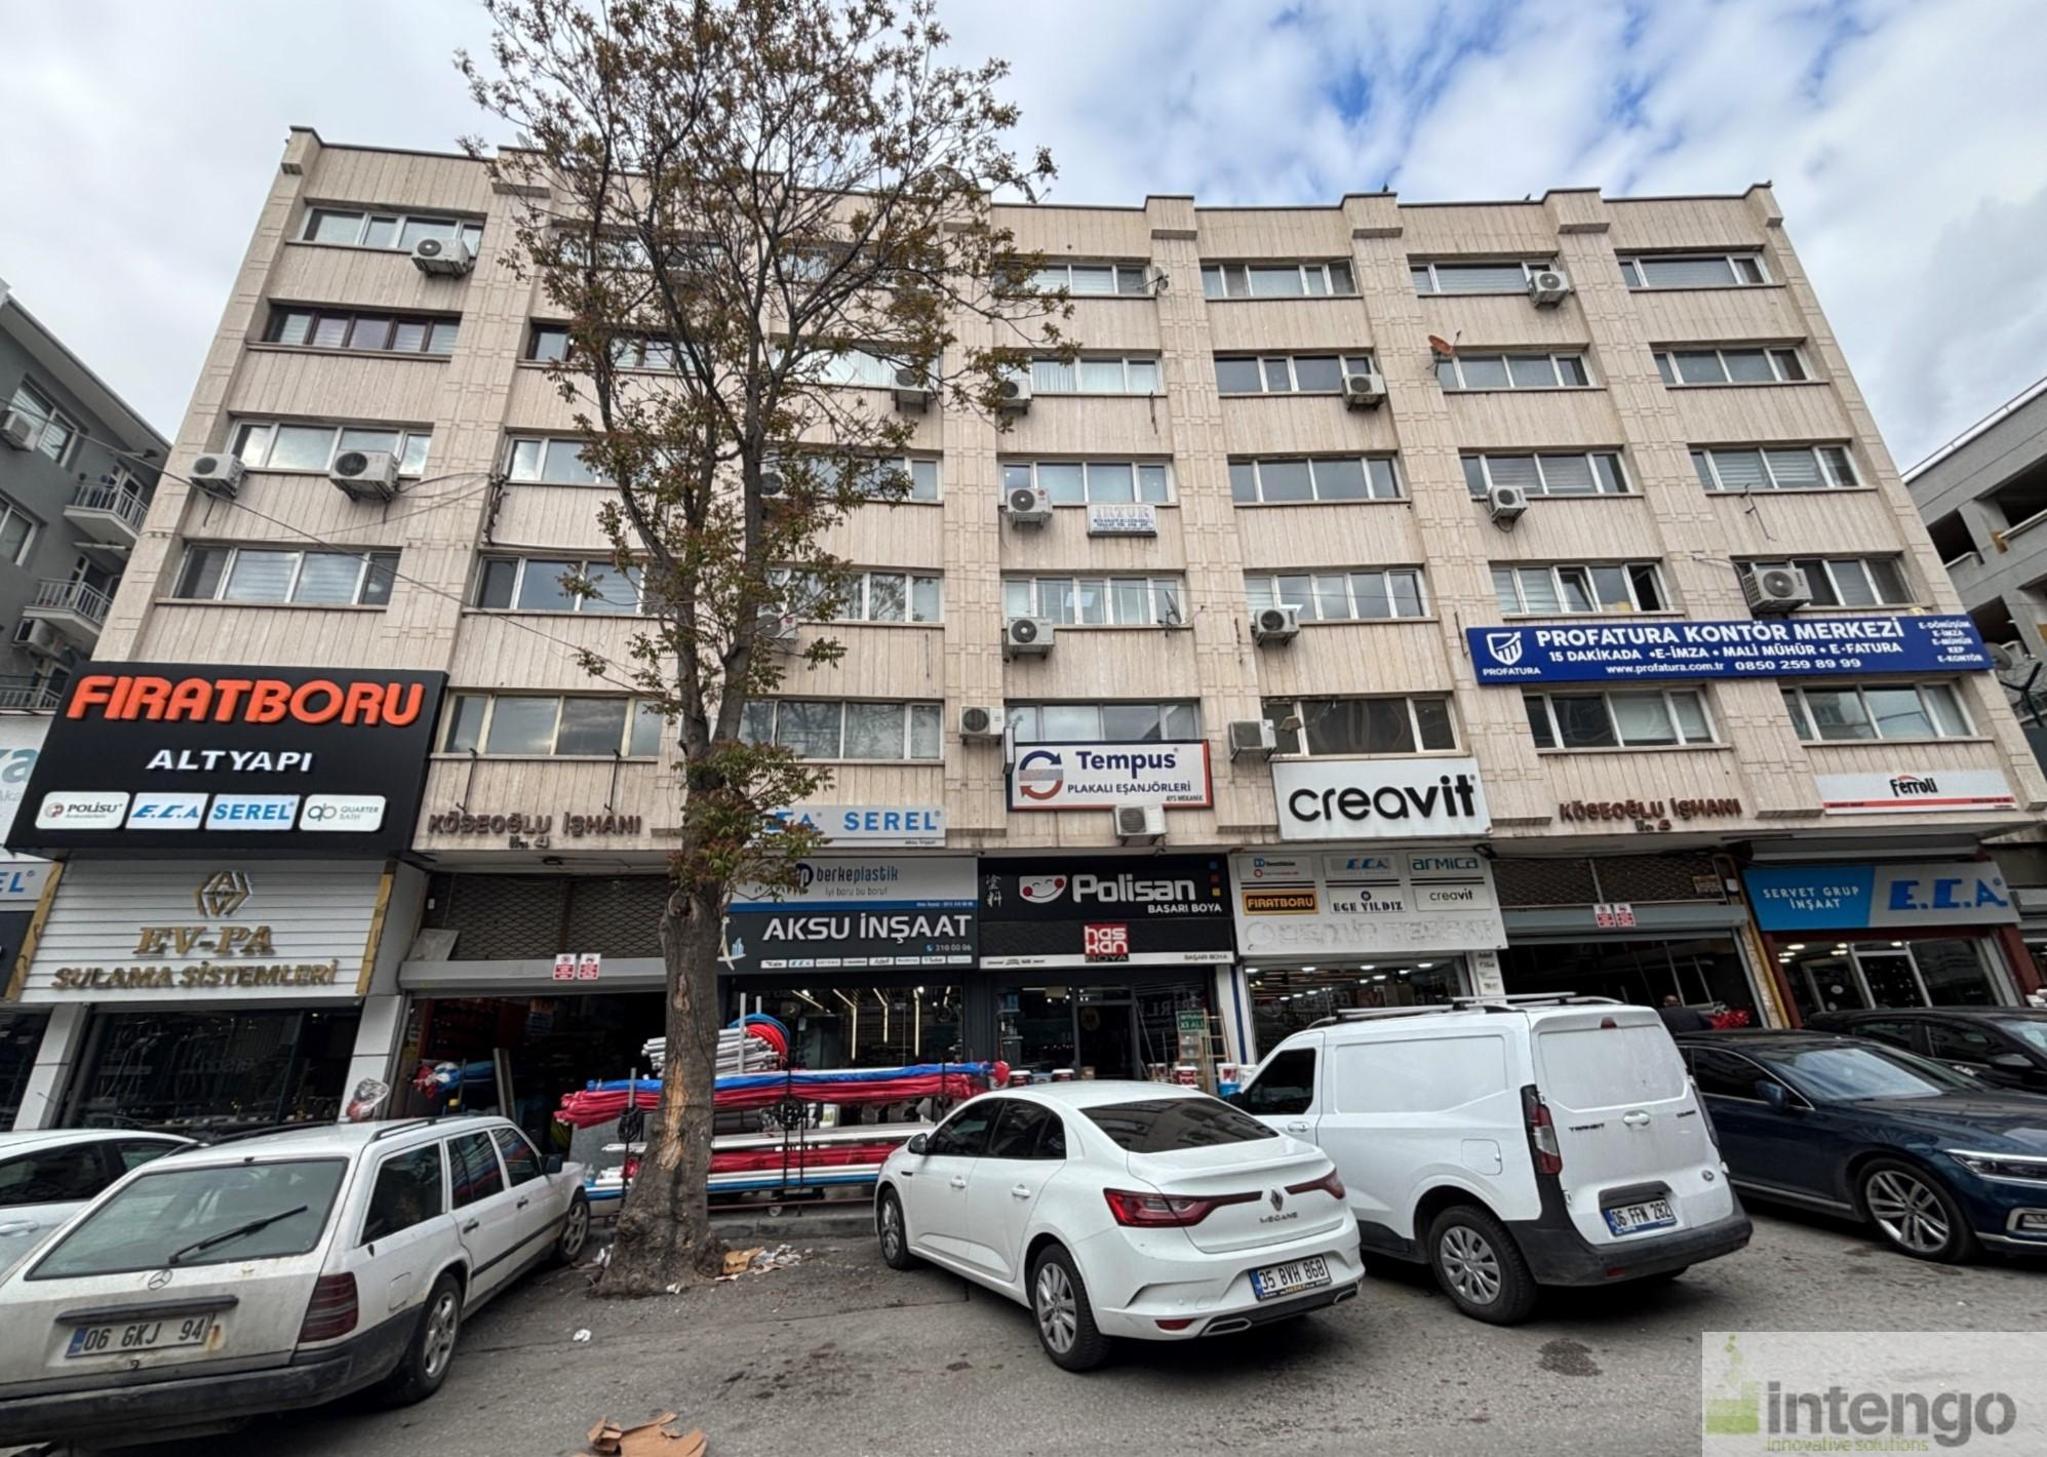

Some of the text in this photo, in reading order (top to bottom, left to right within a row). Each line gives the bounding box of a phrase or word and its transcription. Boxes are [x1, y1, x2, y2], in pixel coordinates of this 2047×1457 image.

[1535, 616, 1905, 647] PROFATURA KONTÖR MERKEZİ
[1548, 651, 1564, 662] 15
[1566, 648, 1642, 662] DAKİKADA
[1656, 646, 1710, 659] E-İMZA
[1723, 644, 1760, 657] MALİ
[1762, 642, 1816, 656] MÜHÜR
[1482, 667, 1542, 676] PROFATURA
[1606, 657, 1862, 674] www.profatura.com.tr 0850 259 89 99
[65, 674, 426, 727] FIRATBORU
[145, 748, 314, 773] ALTYAPI
[1075, 750, 1177, 780] Tempus
[1067, 780, 1191, 796] PLAKALI EŞANJÖRLERİ
[1288, 773, 1475, 822] creavit
[1889, 777, 1939, 798] Ferroli
[67, 802, 117, 814] POLİSU
[212, 803, 291, 821] SEREL
[843, 811, 937, 831] SEREL
[816, 865, 898, 883] berkeplastik
[1072, 873, 1196, 903] Polisan
[1429, 888, 1473, 901] creavit
[1763, 886, 1860, 899] SERVET GRUP
[1191, 903, 1222, 913] BOYA
[1248, 897, 1314, 908] FIRATBORU
[1361, 901, 1403, 912] YILDIZ
[1790, 897, 1841, 911] İNŞAAT
[761, 913, 972, 944] AKSU İNŞAAT
[132, 924, 276, 956] EV-PA
[51, 957, 340, 990] SULAMA SİSTEMLERİ
[1259, 1270, 1276, 1290] 35
[1278, 1263, 1302, 1286] BVH
[83, 1327, 112, 1351] 06
[121, 1322, 162, 1347] GKJ
